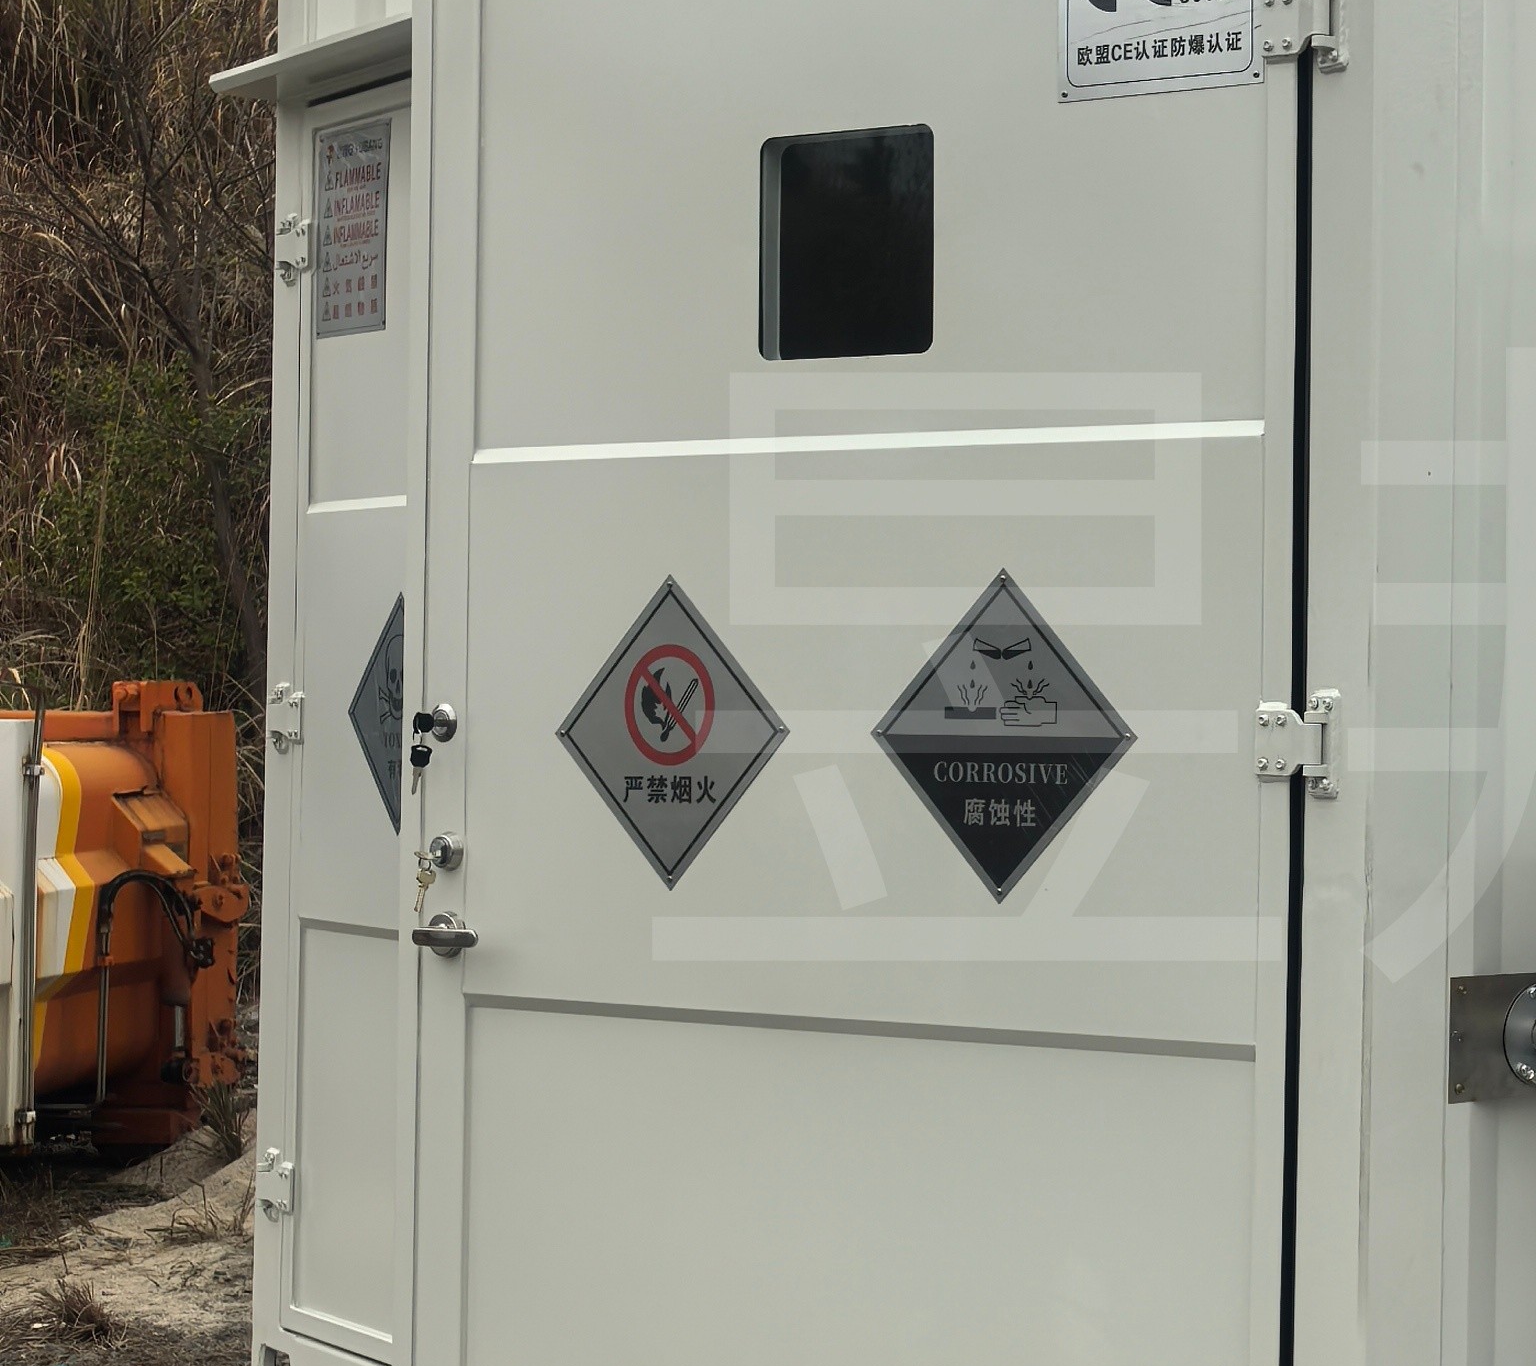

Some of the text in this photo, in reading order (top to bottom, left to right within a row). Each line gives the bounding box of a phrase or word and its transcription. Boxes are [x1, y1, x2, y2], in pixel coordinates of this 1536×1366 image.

[1077, 31, 1243, 67] 欧盟CE认证防爆认证
[933, 760, 1069, 786] CORROSIVE
[623, 775, 717, 805] 严禁烟火
[962, 797, 1037, 828] 腐蚀性
